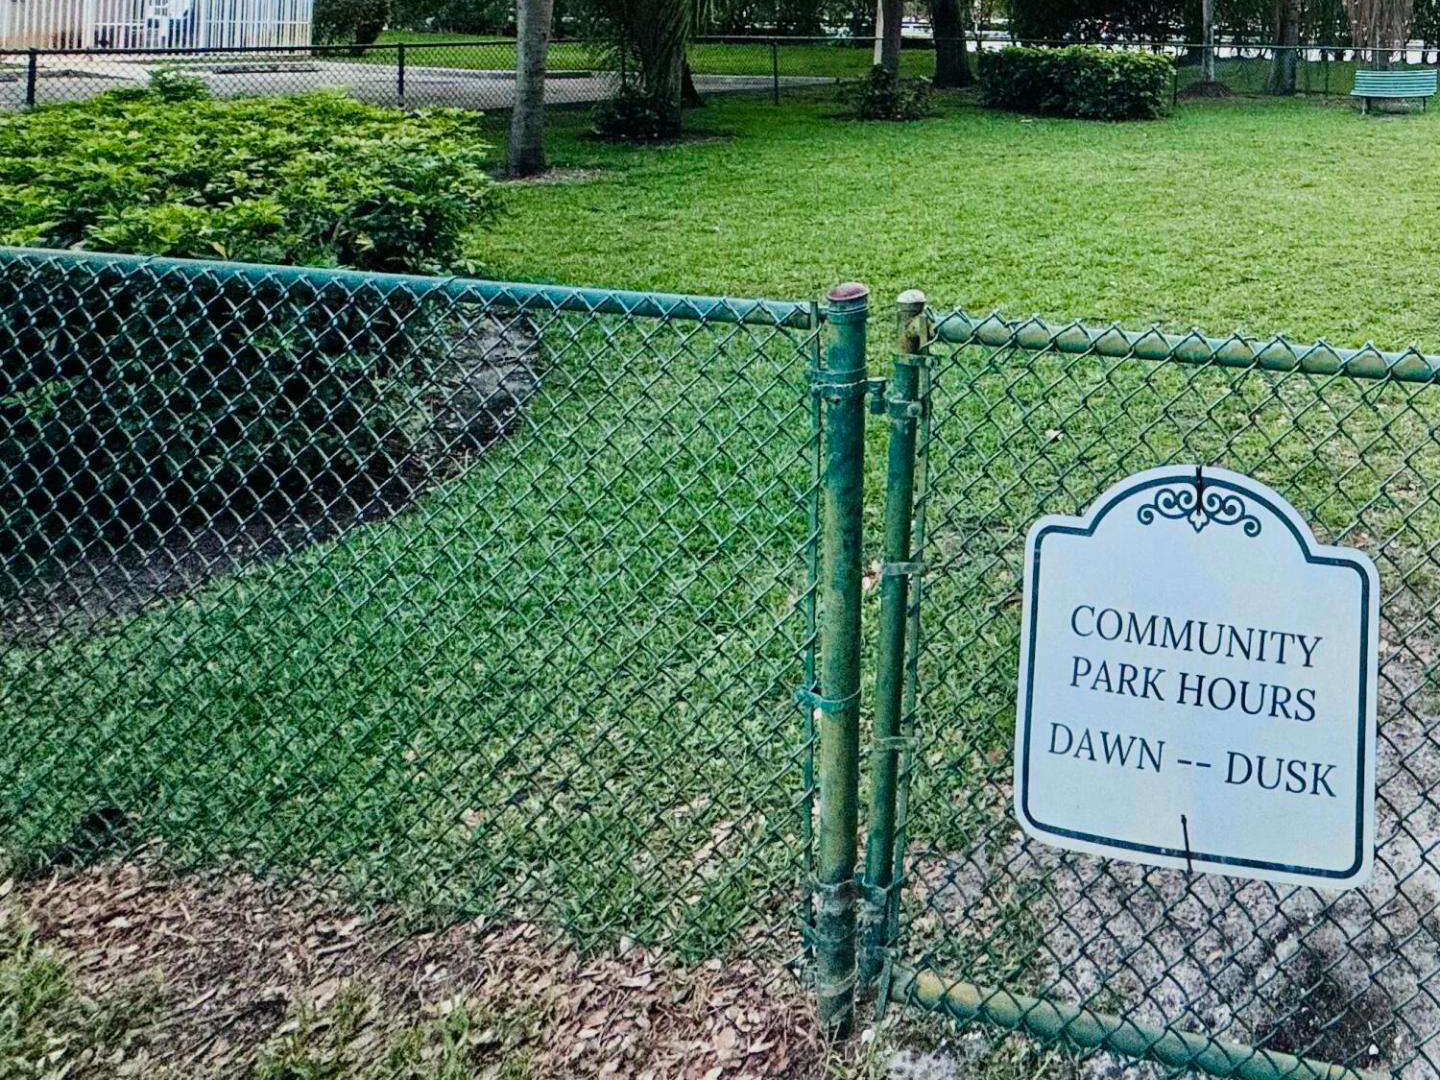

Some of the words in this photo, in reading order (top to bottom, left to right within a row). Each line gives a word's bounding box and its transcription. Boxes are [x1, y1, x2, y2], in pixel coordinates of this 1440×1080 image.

[1071, 604, 1323, 668] COMMUNITY
[1069, 656, 1165, 701] PARK
[1176, 672, 1317, 722] HOURS
[1048, 722, 1166, 773] DAWN
[1224, 751, 1337, 798] DUSK
